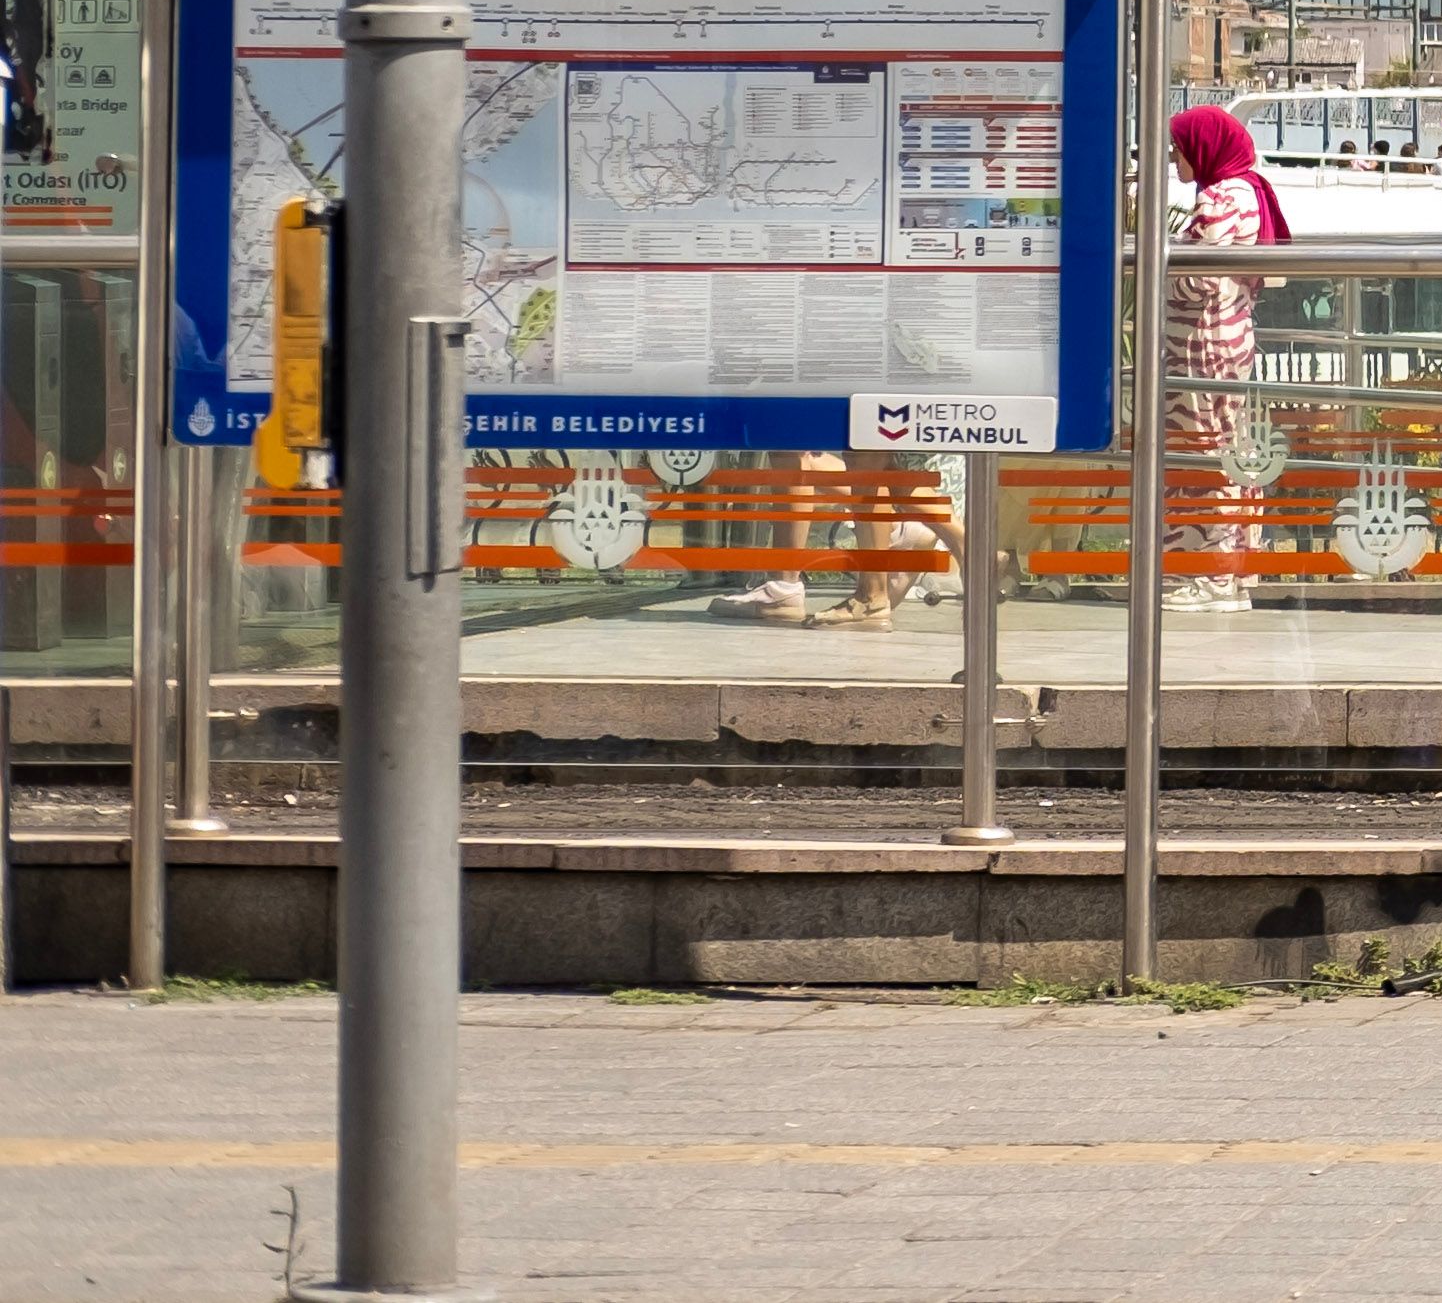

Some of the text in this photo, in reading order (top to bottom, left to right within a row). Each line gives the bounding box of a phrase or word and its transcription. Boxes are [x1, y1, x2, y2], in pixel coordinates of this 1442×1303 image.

[81, 98, 128, 118] Bridge
[17, 172, 71, 189] Odası
[78, 168, 127, 193] (İTO)
[12, 194, 87, 206] Commerce
[916, 403, 997, 421] METRO
[552, 412, 705, 433] BELEDİYESİ
[916, 423, 1028, 444] İSTANBUL
